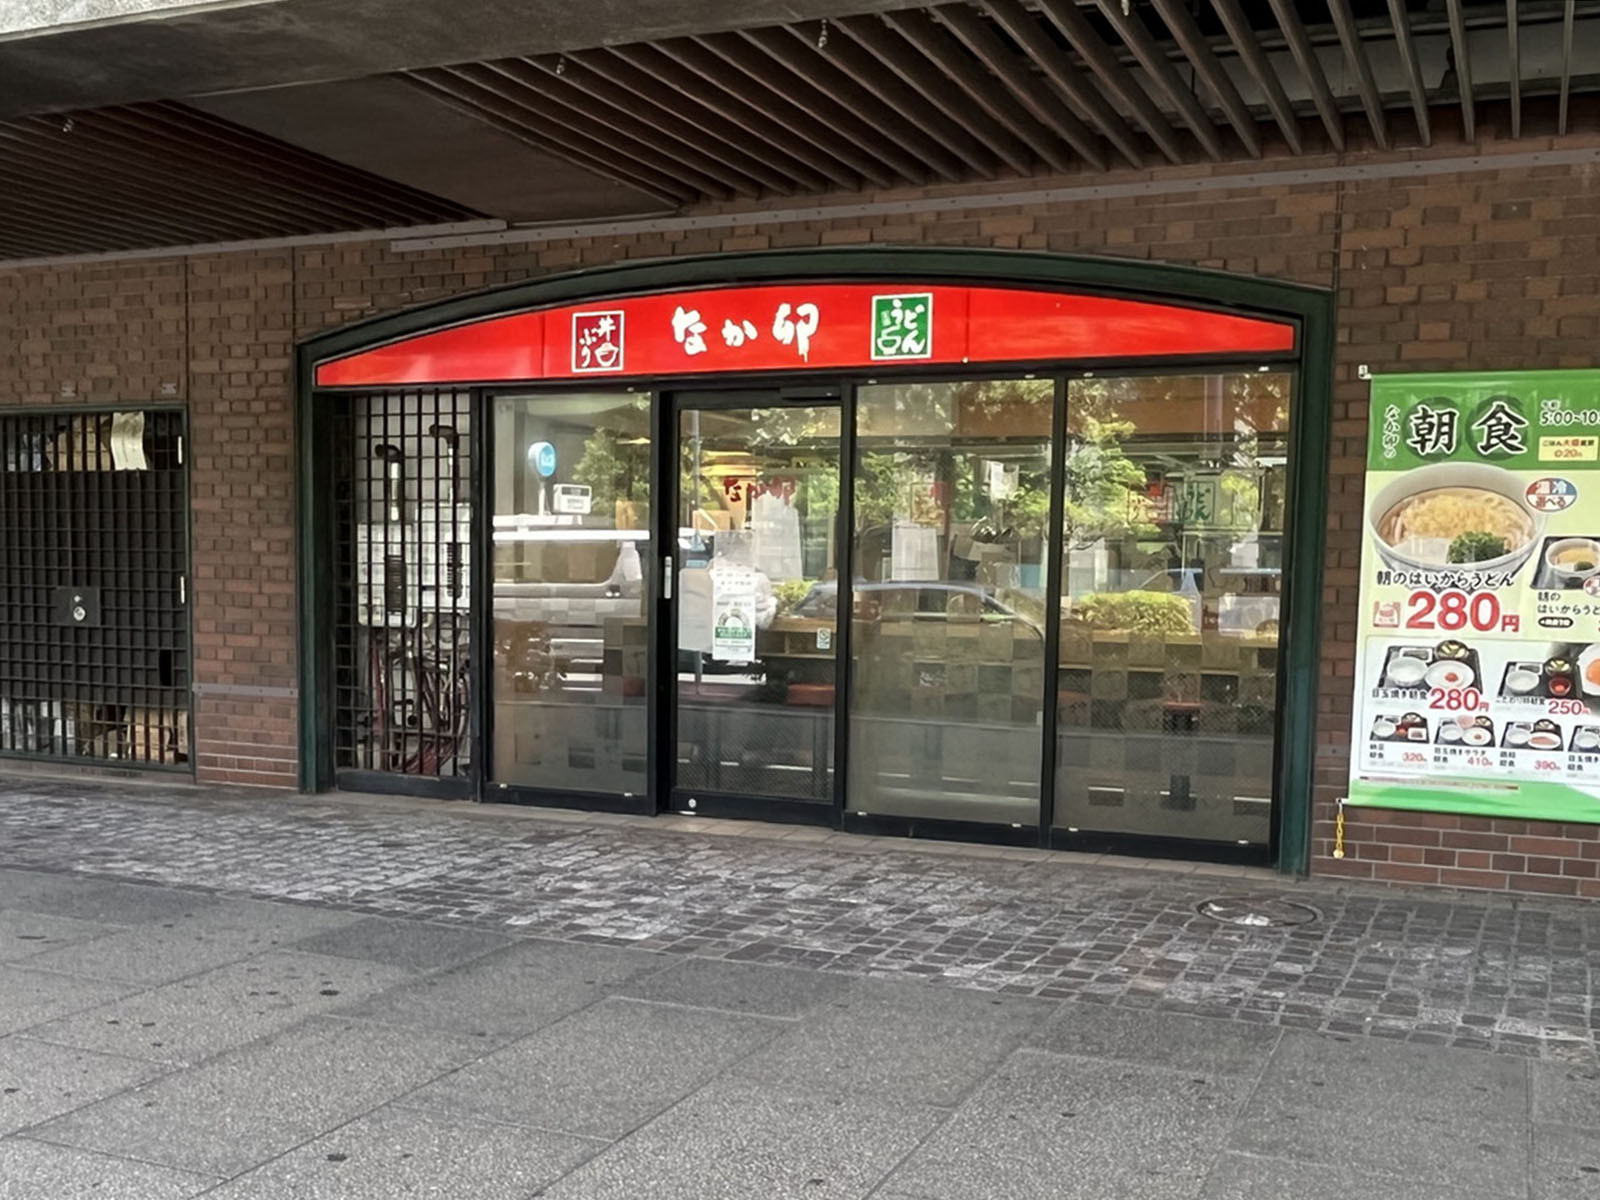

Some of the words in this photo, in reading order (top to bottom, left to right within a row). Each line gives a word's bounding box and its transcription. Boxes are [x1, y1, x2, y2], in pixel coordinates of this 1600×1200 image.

[671, 303, 819, 362] なか卯
[1408, 402, 1528, 455] 朝食
[1406, 590, 1520, 632] 280円
[1429, 687, 1490, 711] 280円
